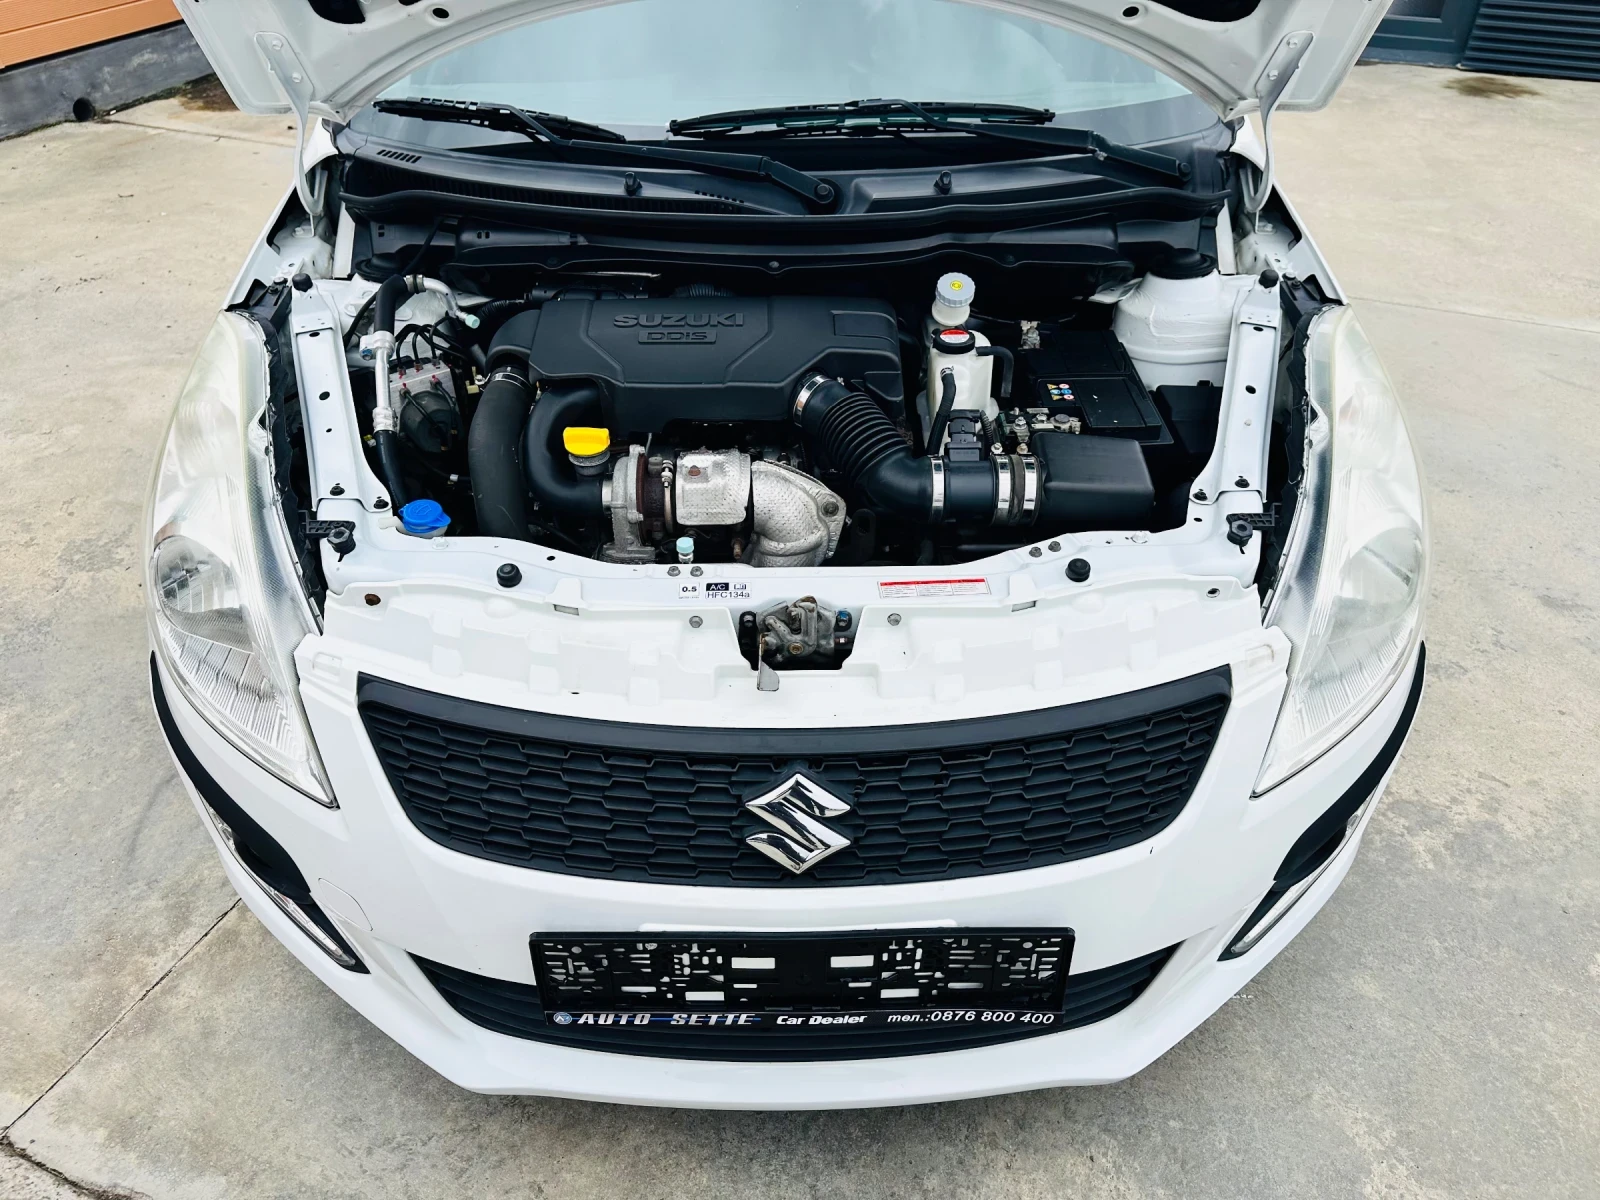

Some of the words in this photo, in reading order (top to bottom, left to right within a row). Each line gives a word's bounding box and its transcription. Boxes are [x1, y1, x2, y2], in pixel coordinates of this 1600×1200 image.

[613, 312, 744, 328] SUZUKI
[577, 1013, 651, 1025] AUTO
[670, 1013, 756, 1026] SETTE
[776, 1015, 806, 1025] Car
[808, 1015, 868, 1025] Dealer
[981, 1011, 1016, 1023] 800
[1019, 1013, 1055, 1024] 400
